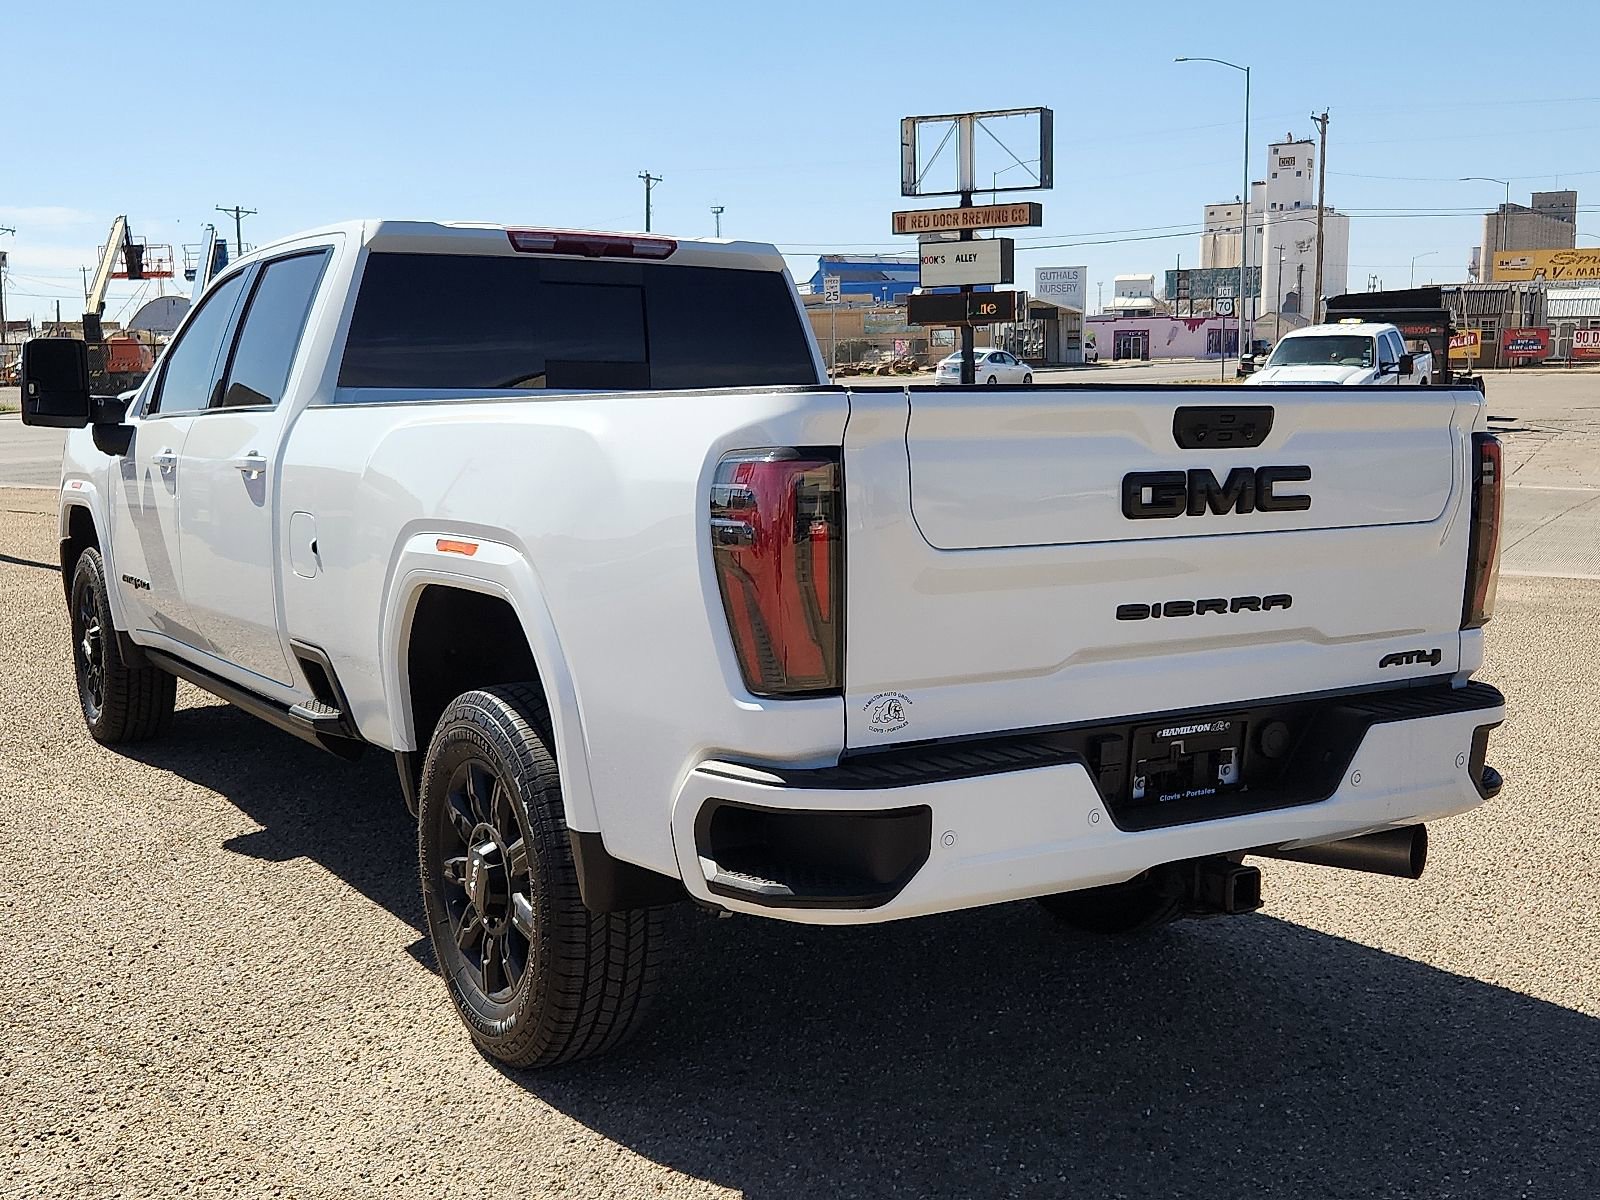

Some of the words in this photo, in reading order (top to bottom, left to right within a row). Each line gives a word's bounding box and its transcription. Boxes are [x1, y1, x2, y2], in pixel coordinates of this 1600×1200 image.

[911, 215, 930, 229] RED
[933, 213, 959, 227] DOOR
[962, 209, 1008, 226] BREWING
[1011, 208, 1029, 222] CO.
[955, 253, 978, 263] ALLEY
[1040, 270, 1078, 281] GUTHALS
[1040, 283, 1077, 293] NURSERY
[1218, 288, 1231, 297] JCT
[825, 291, 839, 302] 25
[1217, 301, 1231, 312] 70
[1576, 331, 1589, 344] 90
[1592, 331, 1600, 344] D
[1121, 465, 1312, 520] GMC
[1116, 594, 1293, 621] SIERRA
[1379, 648, 1442, 669] AT4
[1161, 723, 1212, 737] HAMILTON
[1160, 793, 1181, 802] Clovis
[1186, 787, 1216, 798] Portales
